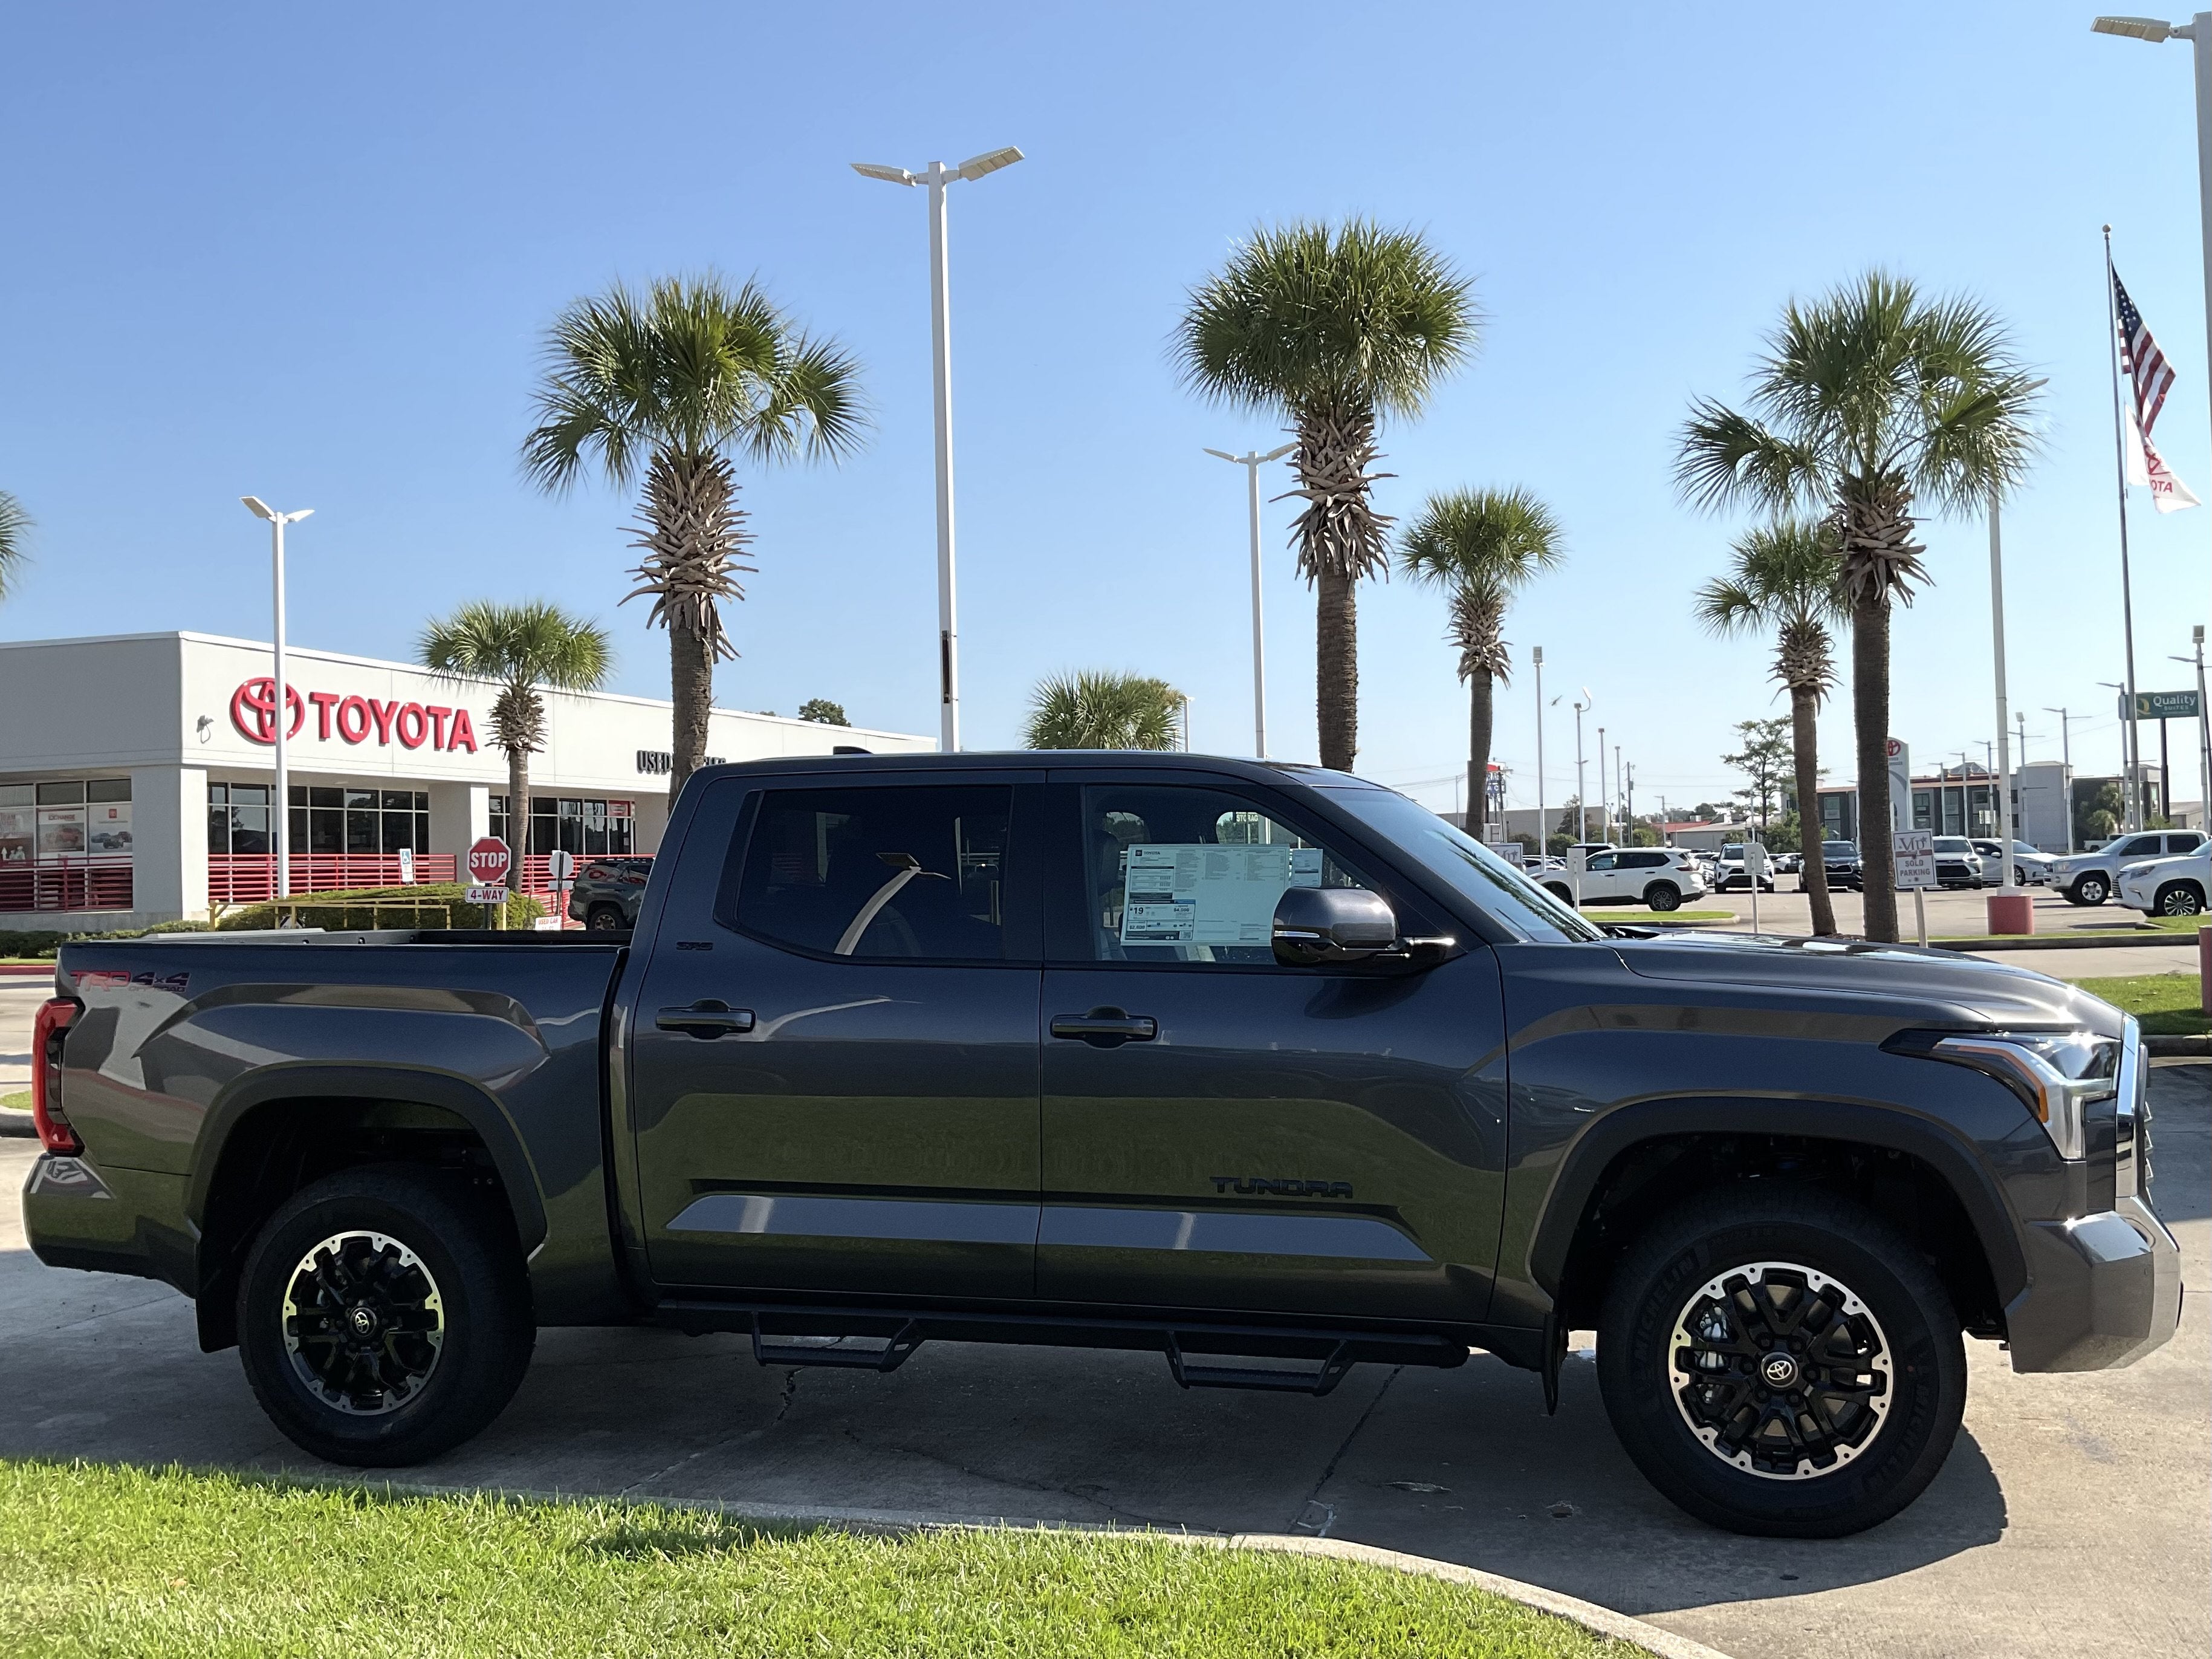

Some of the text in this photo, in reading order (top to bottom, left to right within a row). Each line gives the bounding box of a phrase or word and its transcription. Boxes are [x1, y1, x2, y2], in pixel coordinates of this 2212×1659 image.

[2153, 695, 2196, 707] Quality
[310, 692, 478, 752] TOYOTA
[637, 750, 672, 774] USED
[471, 852, 507, 868] STOP
[1900, 868, 1931, 877] PARKING
[470, 889, 504, 900] 4-WAY
[70, 970, 131, 992] TRD
[1209, 1176, 1353, 1199] TUNDRA
